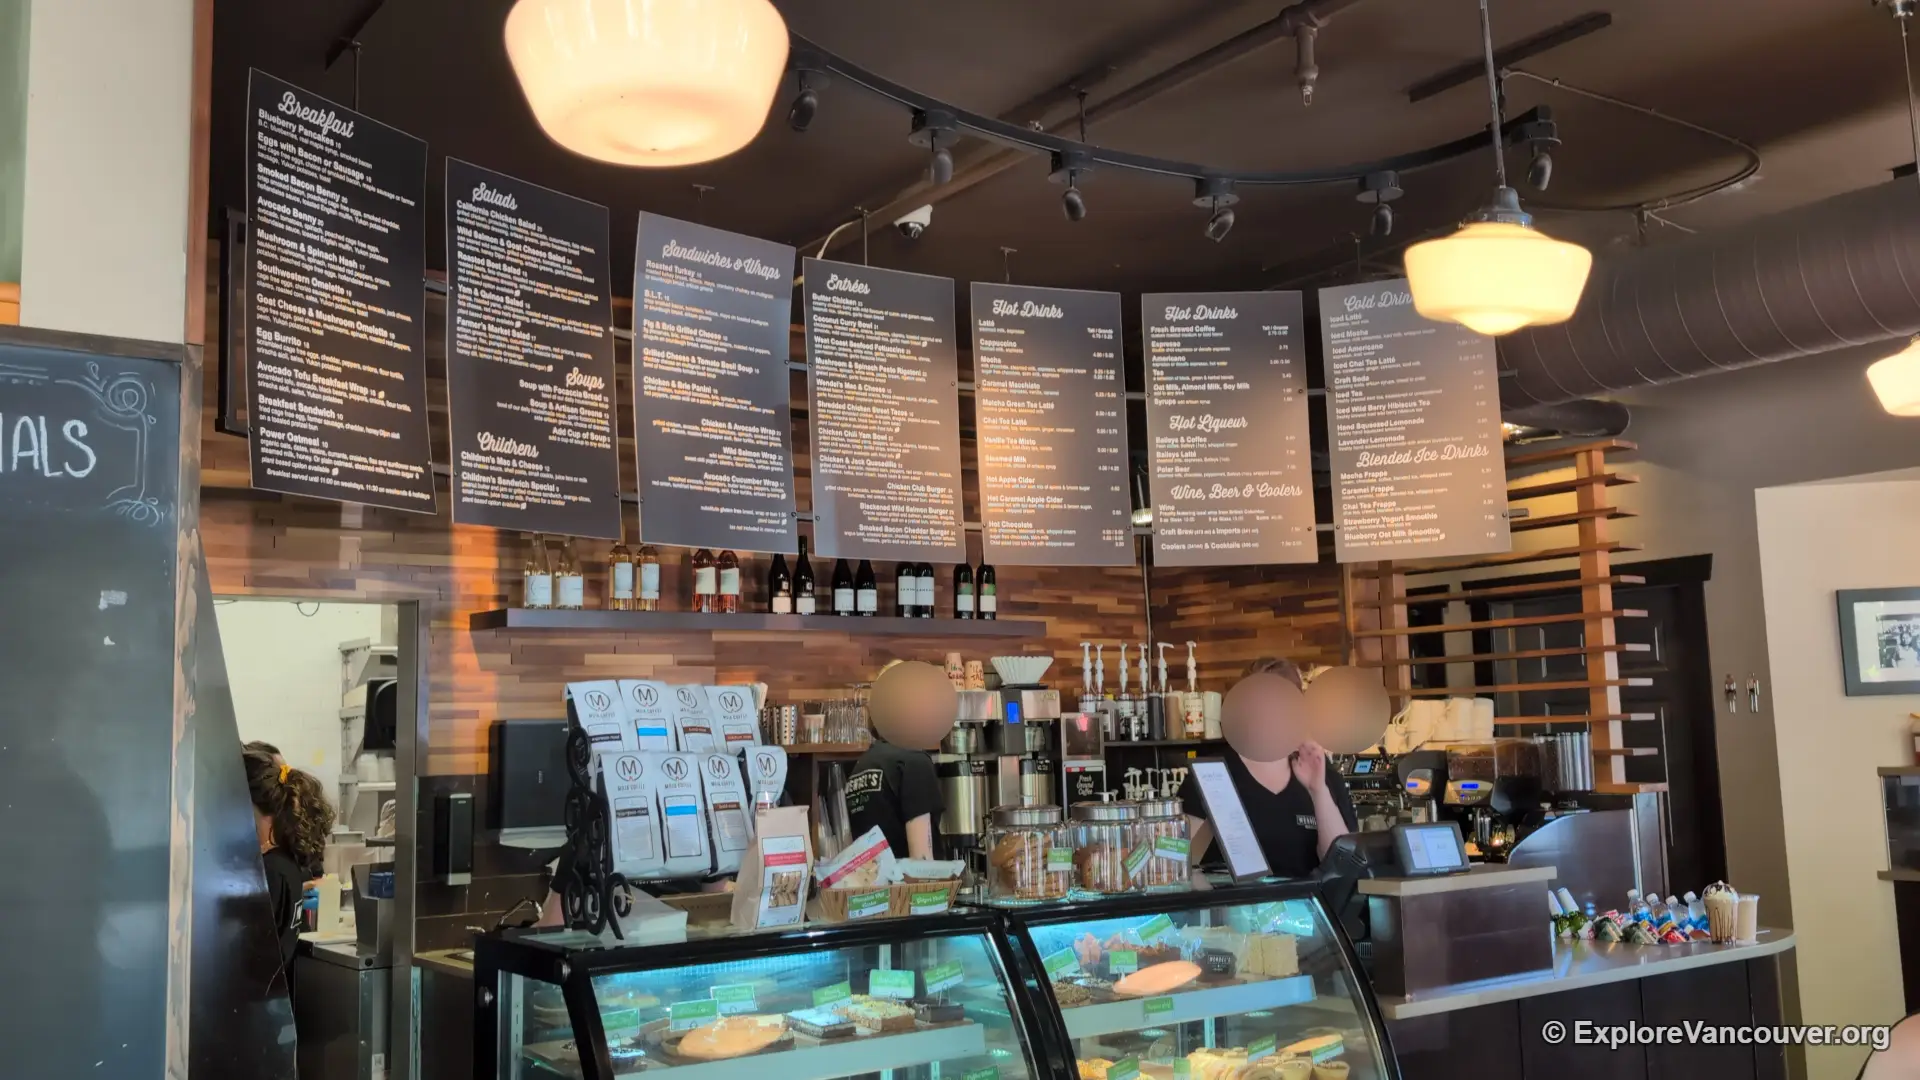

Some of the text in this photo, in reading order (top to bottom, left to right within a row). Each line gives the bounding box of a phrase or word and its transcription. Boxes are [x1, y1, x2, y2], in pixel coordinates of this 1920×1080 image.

[278, 91, 354, 138] Breakfast
[259, 109, 296, 133] Blueberry
[298, 124, 334, 145] Pancakes
[258, 132, 364, 180] Eggs with Bacon or Sausage
[257, 163, 340, 204] Smoked Bacon Benny
[473, 182, 517, 210] Salads
[258, 196, 316, 226] Avocado Benny
[457, 200, 536, 230] California Chicken Salad
[258, 229, 297, 249] Mushroom
[300, 242, 305, 252] &
[307, 245, 337, 262] Spinach
[339, 255, 357, 269] Hash
[457, 225, 565, 263] Wild Salmon & Goat Cheese Salad
[646, 260, 695, 278] Roasted Turkey
[662, 240, 780, 280] Sandwiches & Wraps
[257, 261, 344, 295] Southwestern Omelette
[827, 273, 870, 294] Entrées
[458, 284, 523, 307] Yam & Quinoa Salad
[644, 290, 662, 299] B.L.T.
[1344, 291, 1412, 311] Cold Drin
[257, 293, 387, 337] Goat Cheese & Mushroom Omelette
[993, 300, 1063, 318] Hot Drinks
[1165, 305, 1238, 322] Hot Drinks
[813, 315, 872, 329] Coconut Curry Bowl
[257, 327, 301, 346] Egg Burrito
[980, 339, 1016, 347] Cappuccino
[1348, 345, 1383, 353] Americano
[258, 361, 368, 395] Avocado Tofu Breakfast Wrap
[566, 367, 604, 390] Soups
[520, 379, 602, 400] Soup with Focaccia Bread
[259, 394, 296, 410] Breakfast
[298, 403, 335, 418] Sandwich
[701, 418, 726, 428] Chicken
[733, 423, 759, 433] Avocado
[760, 428, 775, 437] Wrap
[1170, 414, 1248, 433] Hot Liqueur
[260, 427, 285, 440] Power
[287, 433, 319, 446] Oatmeal
[477, 432, 539, 458] Childrens
[553, 427, 566, 436] Add
[568, 429, 582, 440] Cup
[590, 433, 607, 443] Soup
[461, 451, 495, 464] Children's
[497, 457, 510, 466] Mac
[519, 461, 543, 471] Cheese
[723, 446, 777, 461] Wild Salmon Wrap
[1356, 444, 1489, 468] Blended Ice Drinks
[462, 472, 555, 492] Children's Sandwich Special
[704, 472, 779, 488] Avocado Cucumber Wrap
[1171, 482, 1303, 500] Wine, Beer & Coolers
